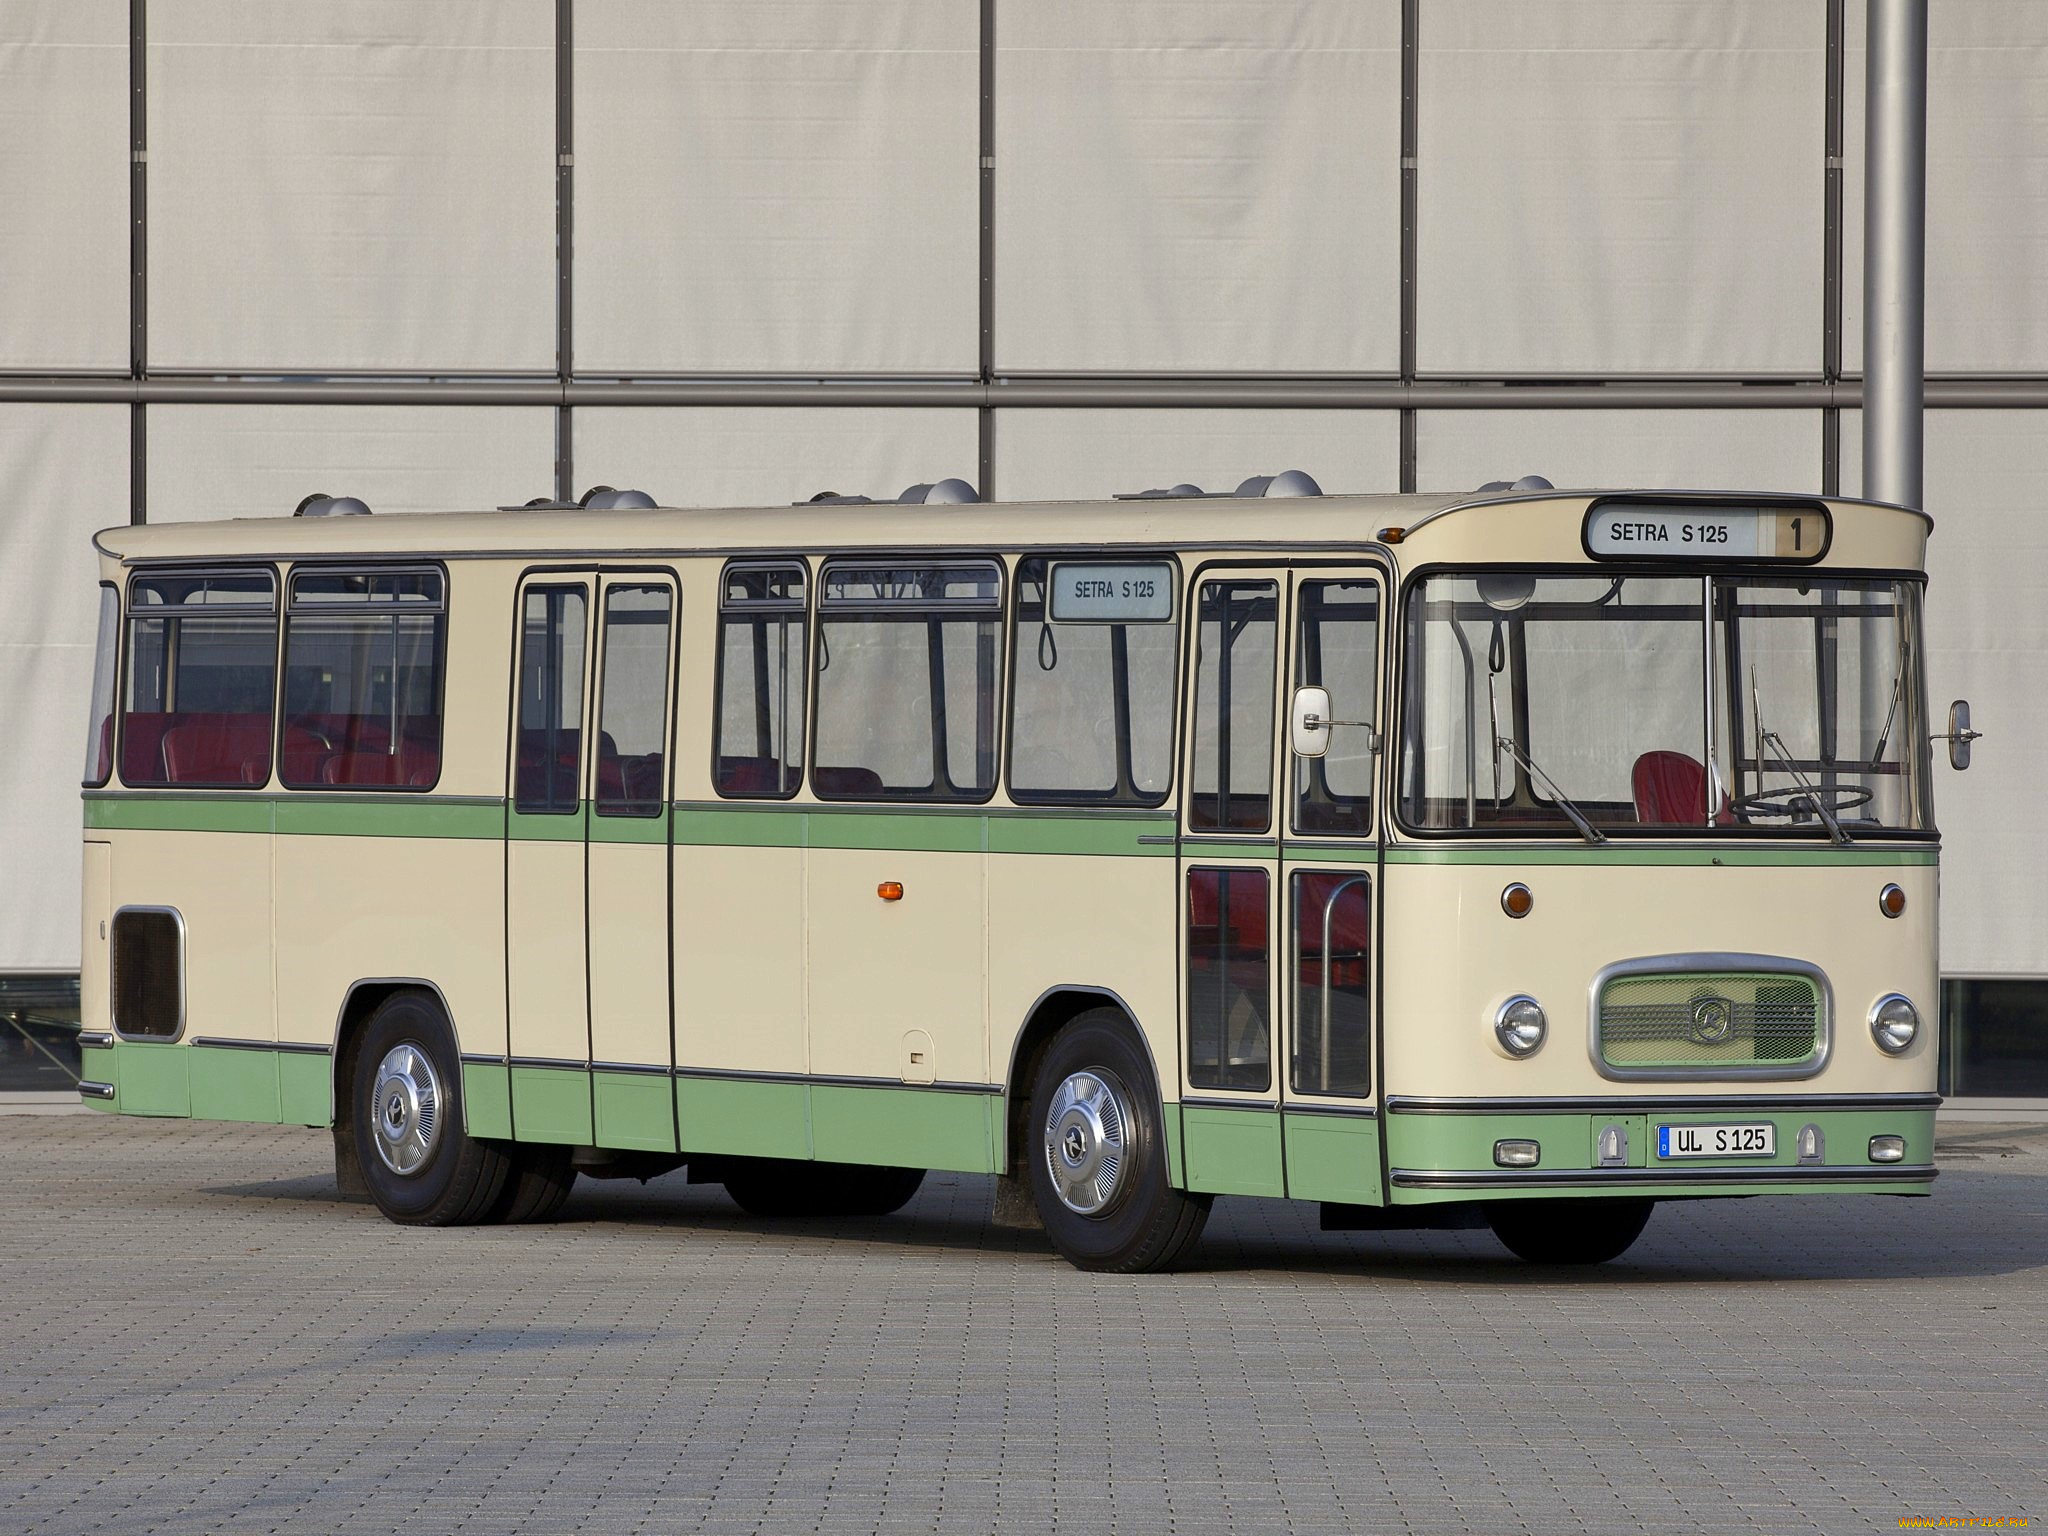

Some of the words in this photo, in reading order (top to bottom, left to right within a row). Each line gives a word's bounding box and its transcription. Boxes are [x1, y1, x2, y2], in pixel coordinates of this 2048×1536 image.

[1610, 522, 1668, 542] SETRA
[1790, 517, 1802, 551] 1
[1075, 581, 1114, 598] SETRA
[1678, 1130, 1702, 1151] UL
